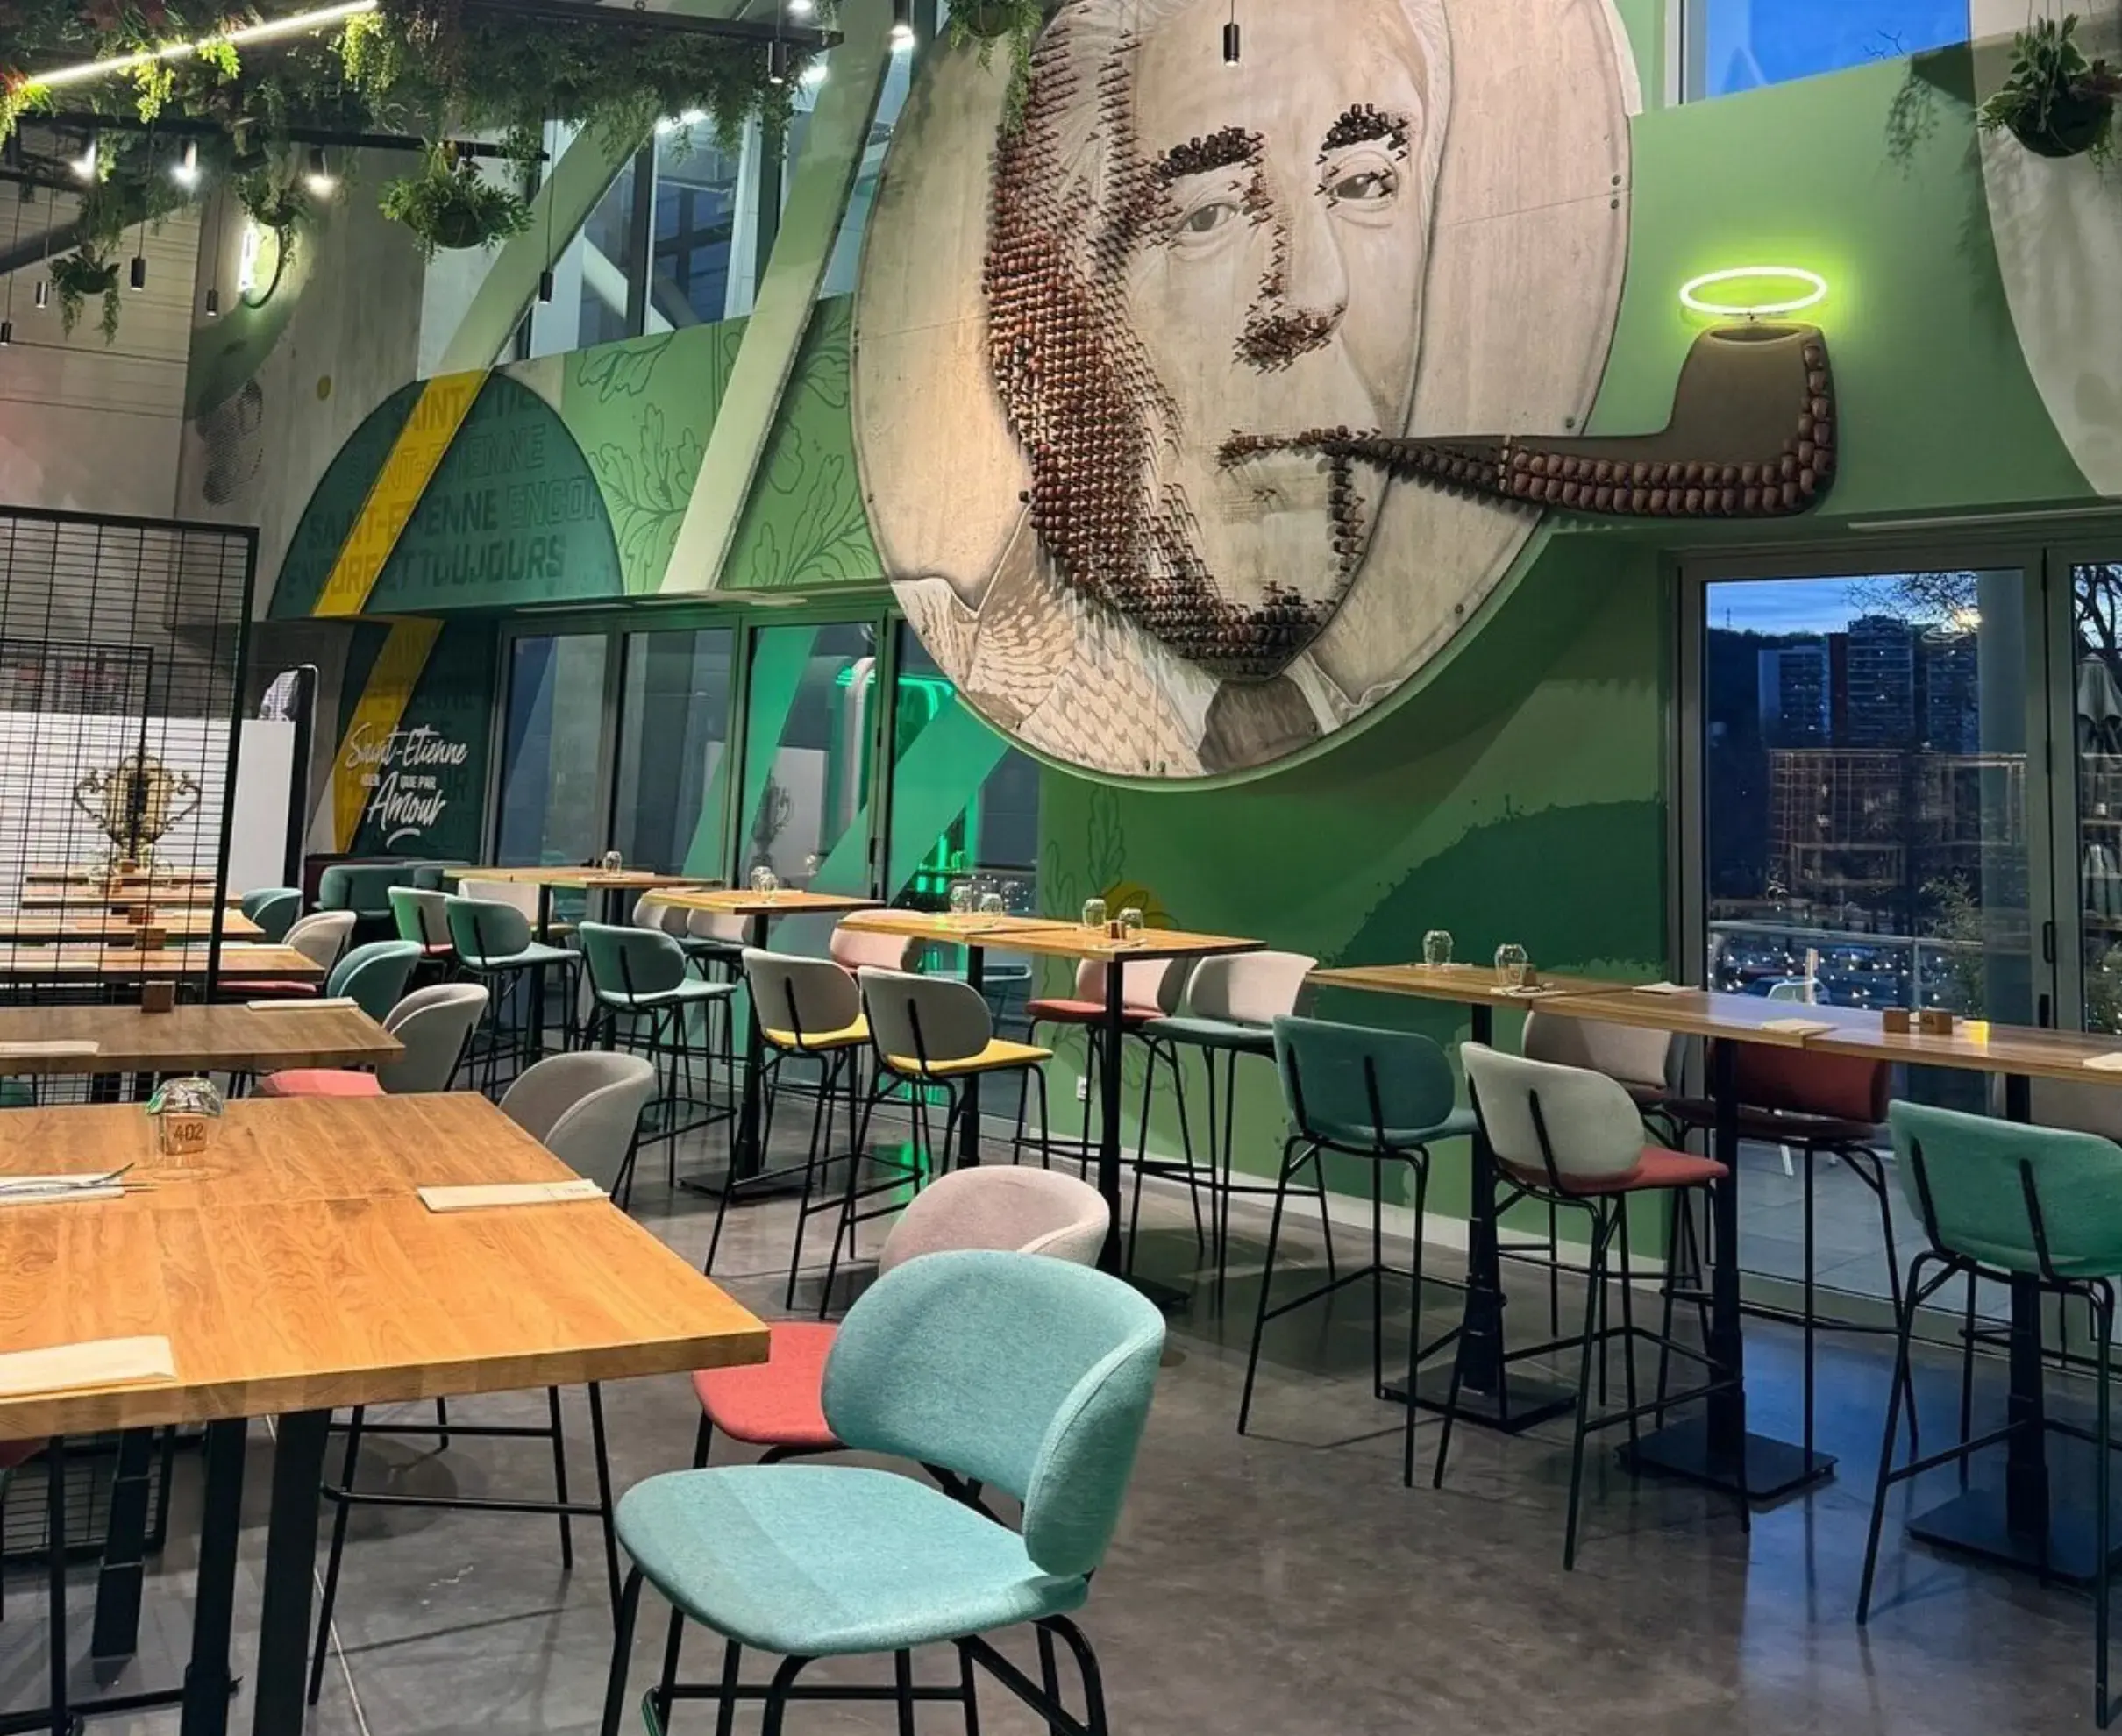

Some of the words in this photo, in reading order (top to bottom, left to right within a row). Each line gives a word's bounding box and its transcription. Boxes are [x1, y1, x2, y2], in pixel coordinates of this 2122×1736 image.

[418, 534, 566, 588] TOUJOURS
[367, 771, 447, 832] Amour
[174, 1122, 203, 1142] 402
